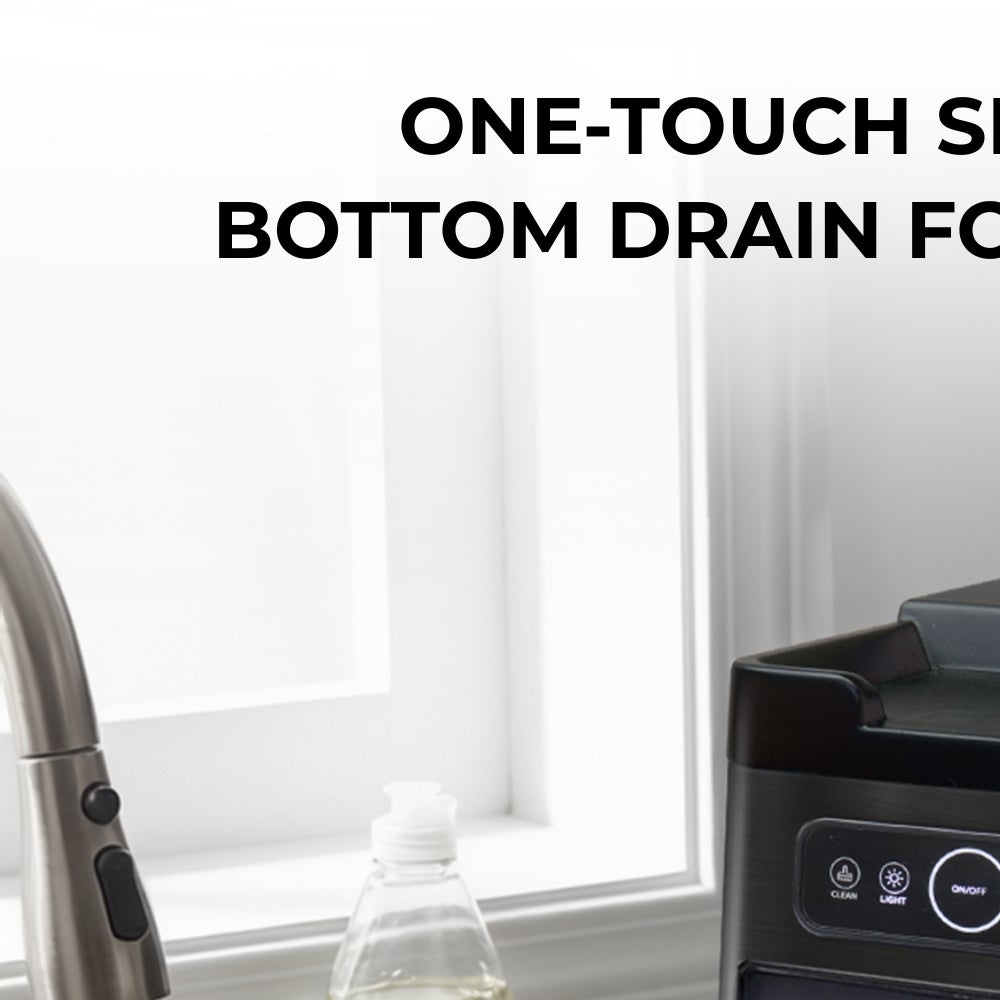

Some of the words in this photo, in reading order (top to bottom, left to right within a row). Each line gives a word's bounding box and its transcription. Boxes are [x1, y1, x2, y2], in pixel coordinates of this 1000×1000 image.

[830, 890, 858, 900] CLEAN
[951, 885, 987, 896] ON/OFF
[880, 895, 907, 905] LIGHT
